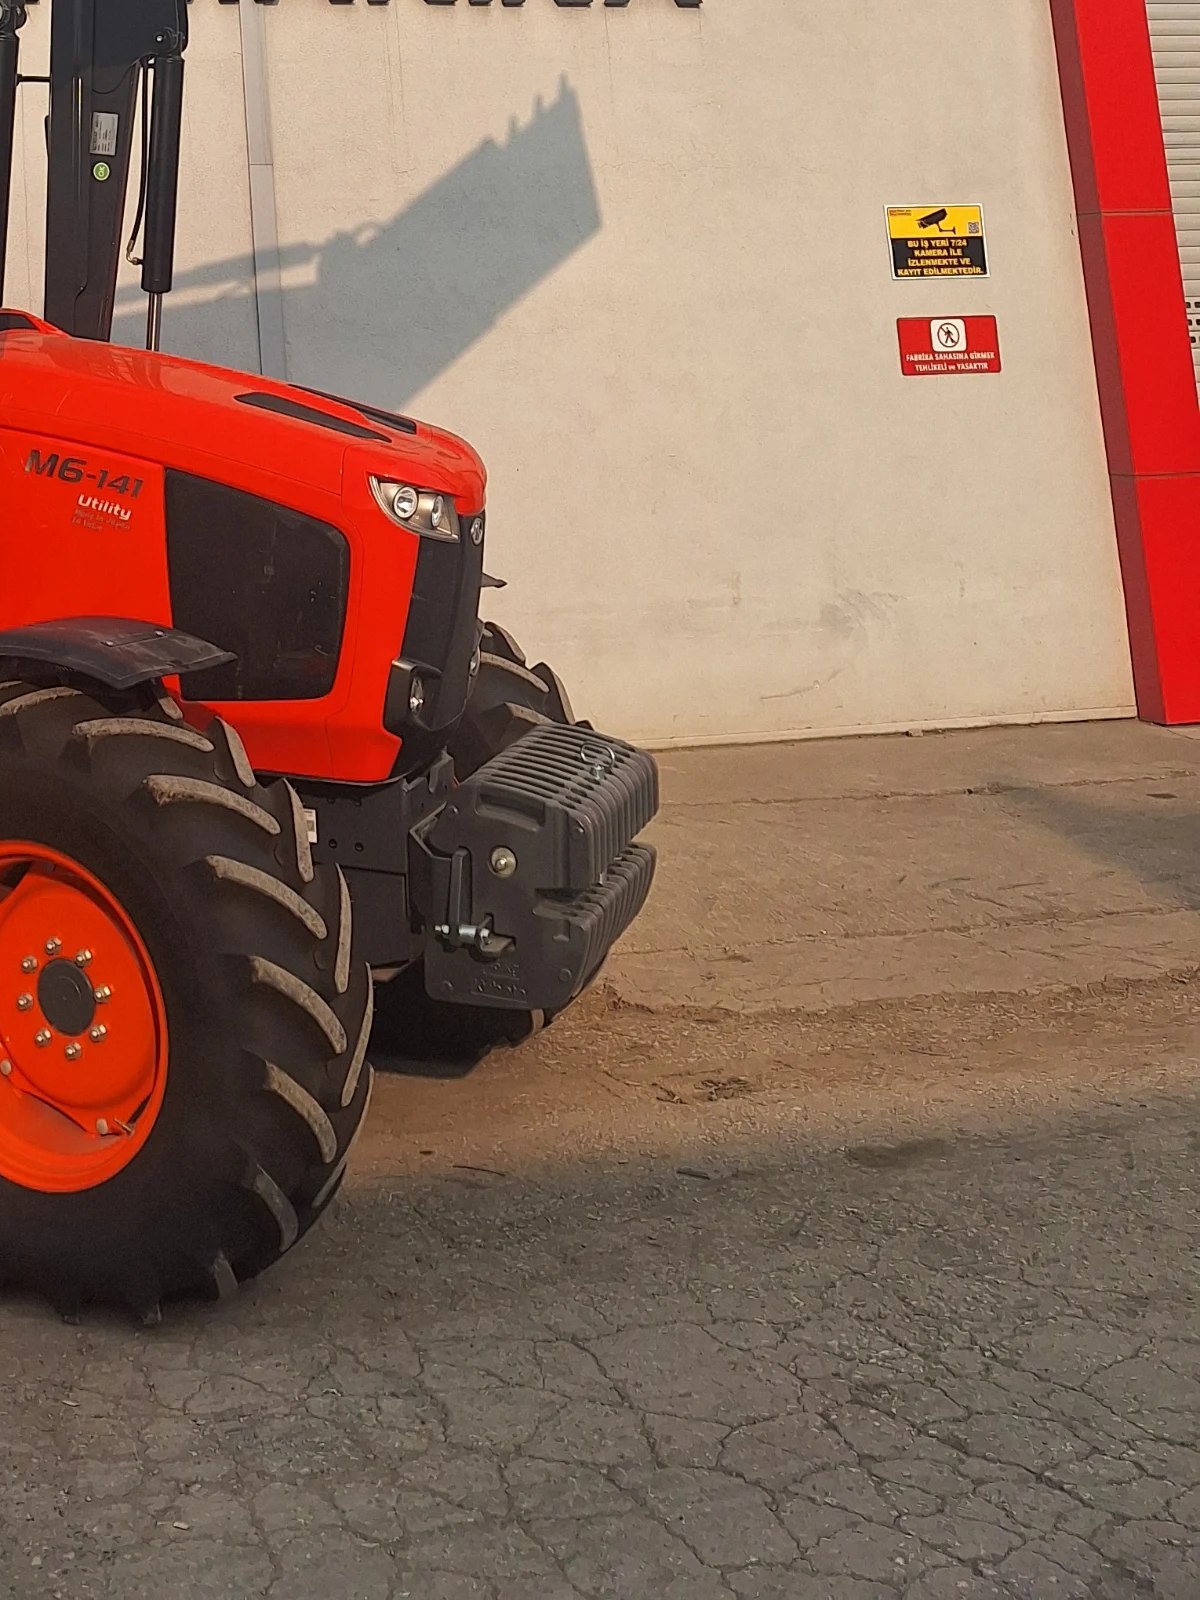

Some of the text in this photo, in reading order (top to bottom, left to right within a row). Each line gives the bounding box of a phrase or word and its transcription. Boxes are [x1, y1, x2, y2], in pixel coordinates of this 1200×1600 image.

[921, 239, 929, 248] İŞ
[930, 238, 949, 247] YERİ
[950, 239, 967, 247] 7/24
[913, 248, 962, 257] KAMERA İLE
[907, 257, 971, 267] İZLENMEKTE VE
[897, 268, 921, 276] KAYIT
[906, 353, 934, 362] FABRİKA
[935, 352, 969, 360] SAHASINA
[957, 362, 988, 370] YASAKTIR
[24, 449, 144, 498] M6-141
[78, 493, 131, 521] Utility
